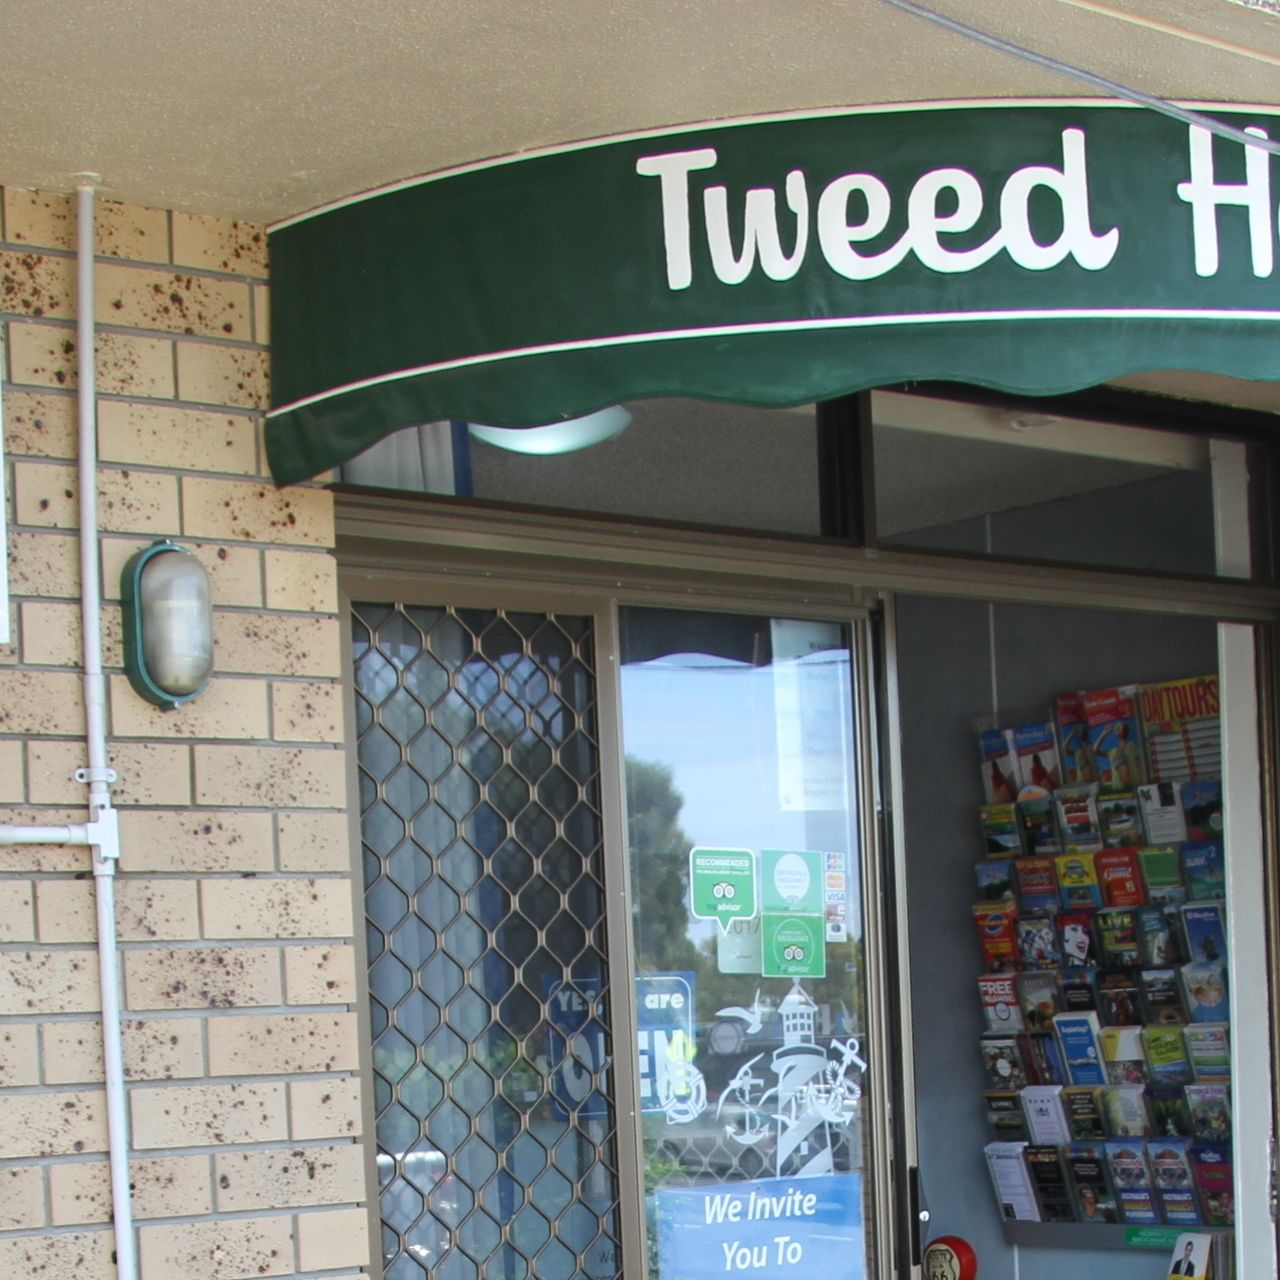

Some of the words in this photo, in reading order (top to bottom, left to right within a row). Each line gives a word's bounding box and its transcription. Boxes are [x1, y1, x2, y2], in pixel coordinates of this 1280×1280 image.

[636, 127, 1120, 292] Tweed
[1163, 678, 1219, 720] TOURS
[695, 857, 750, 867] RECOMMENDED
[645, 993, 685, 1009] are
[978, 981, 1013, 995] FREE
[704, 1193, 742, 1225] We
[748, 1188, 817, 1221] Invite
[722, 1241, 768, 1271] You
[773, 1236, 803, 1265] To
